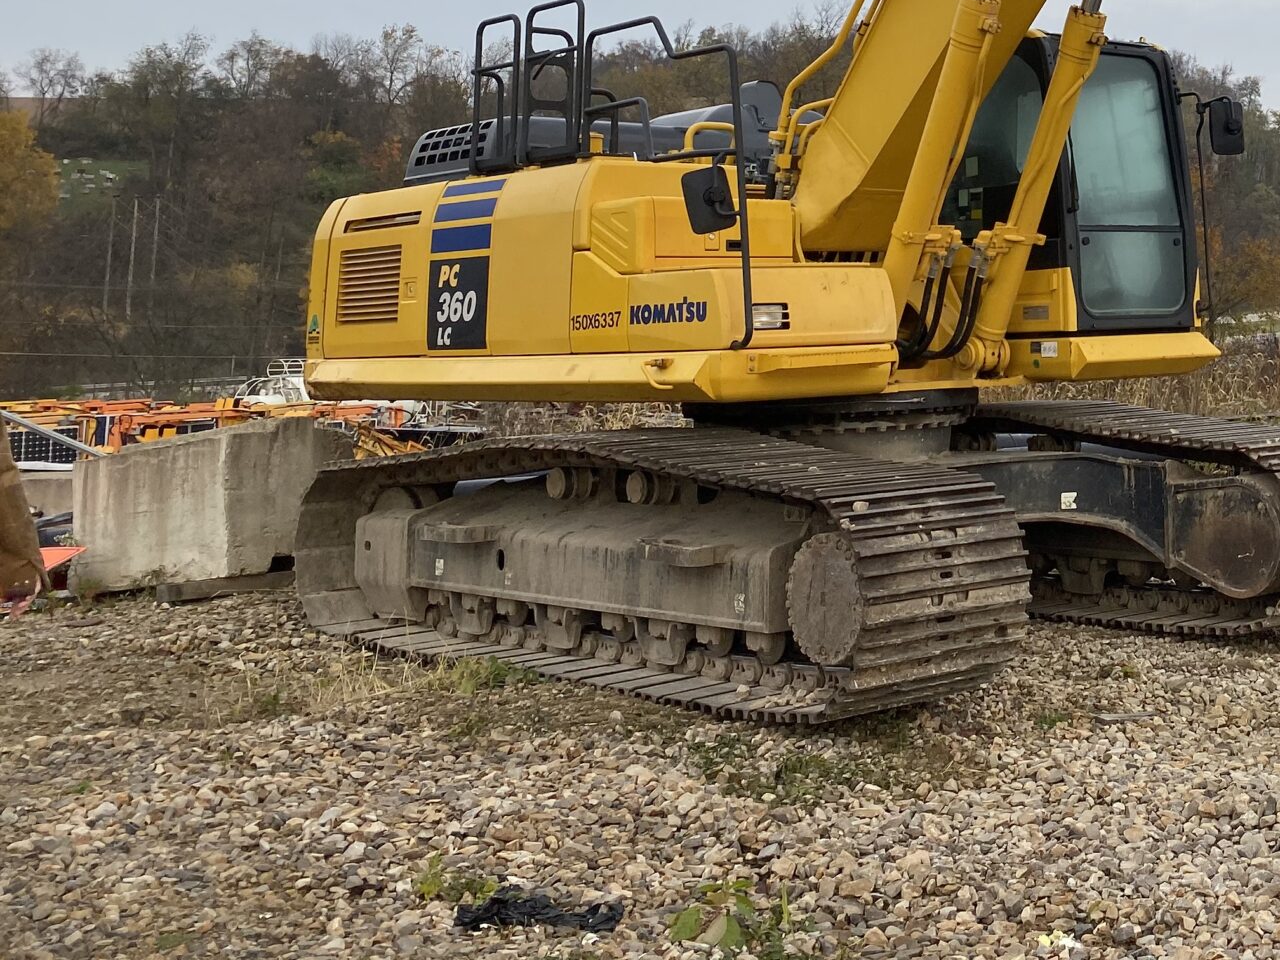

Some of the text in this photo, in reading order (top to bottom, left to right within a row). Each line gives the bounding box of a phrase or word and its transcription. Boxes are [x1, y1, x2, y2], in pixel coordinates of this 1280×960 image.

[438, 263, 460, 288] PC
[436, 290, 477, 322] 360
[629, 296, 707, 325] KOMATSU
[570, 311, 621, 331] 150X6337
[437, 326, 452, 346] LC
